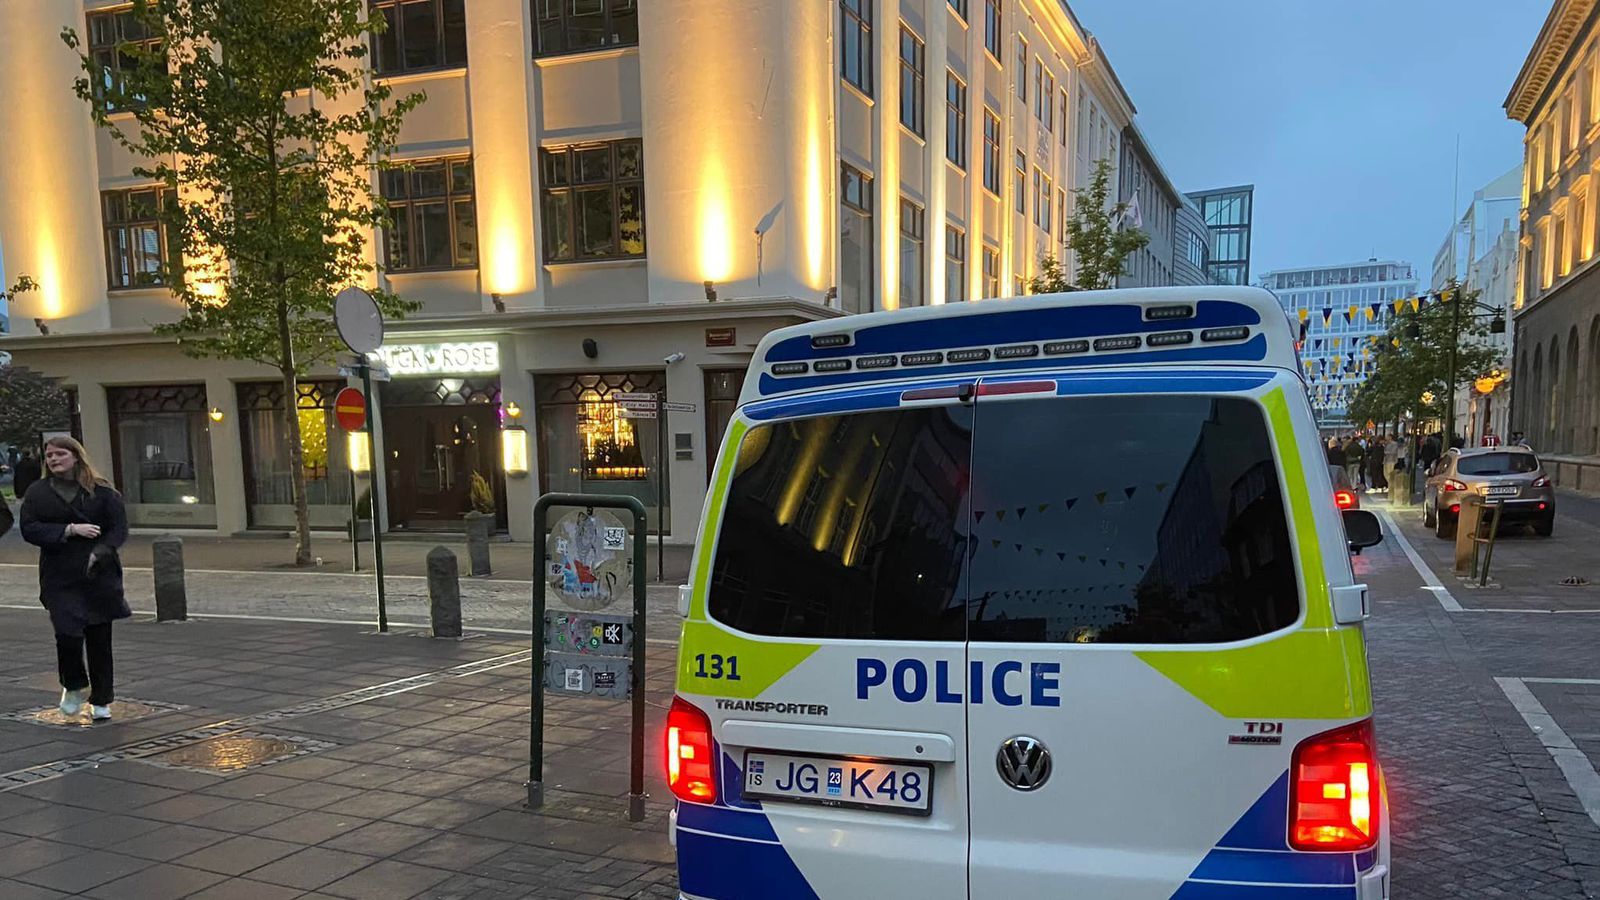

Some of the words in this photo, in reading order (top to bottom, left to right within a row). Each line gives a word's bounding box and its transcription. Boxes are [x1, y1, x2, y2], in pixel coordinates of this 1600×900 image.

[443, 346, 494, 367] ROSE
[694, 653, 742, 681] 131
[856, 657, 1062, 708] POLICE
[715, 699, 829, 717] TRANSPORTER
[1243, 721, 1284, 735] TDI
[749, 773, 763, 786] IS
[775, 761, 820, 794] JG
[829, 772, 842, 785] 23
[850, 767, 922, 803] K48
